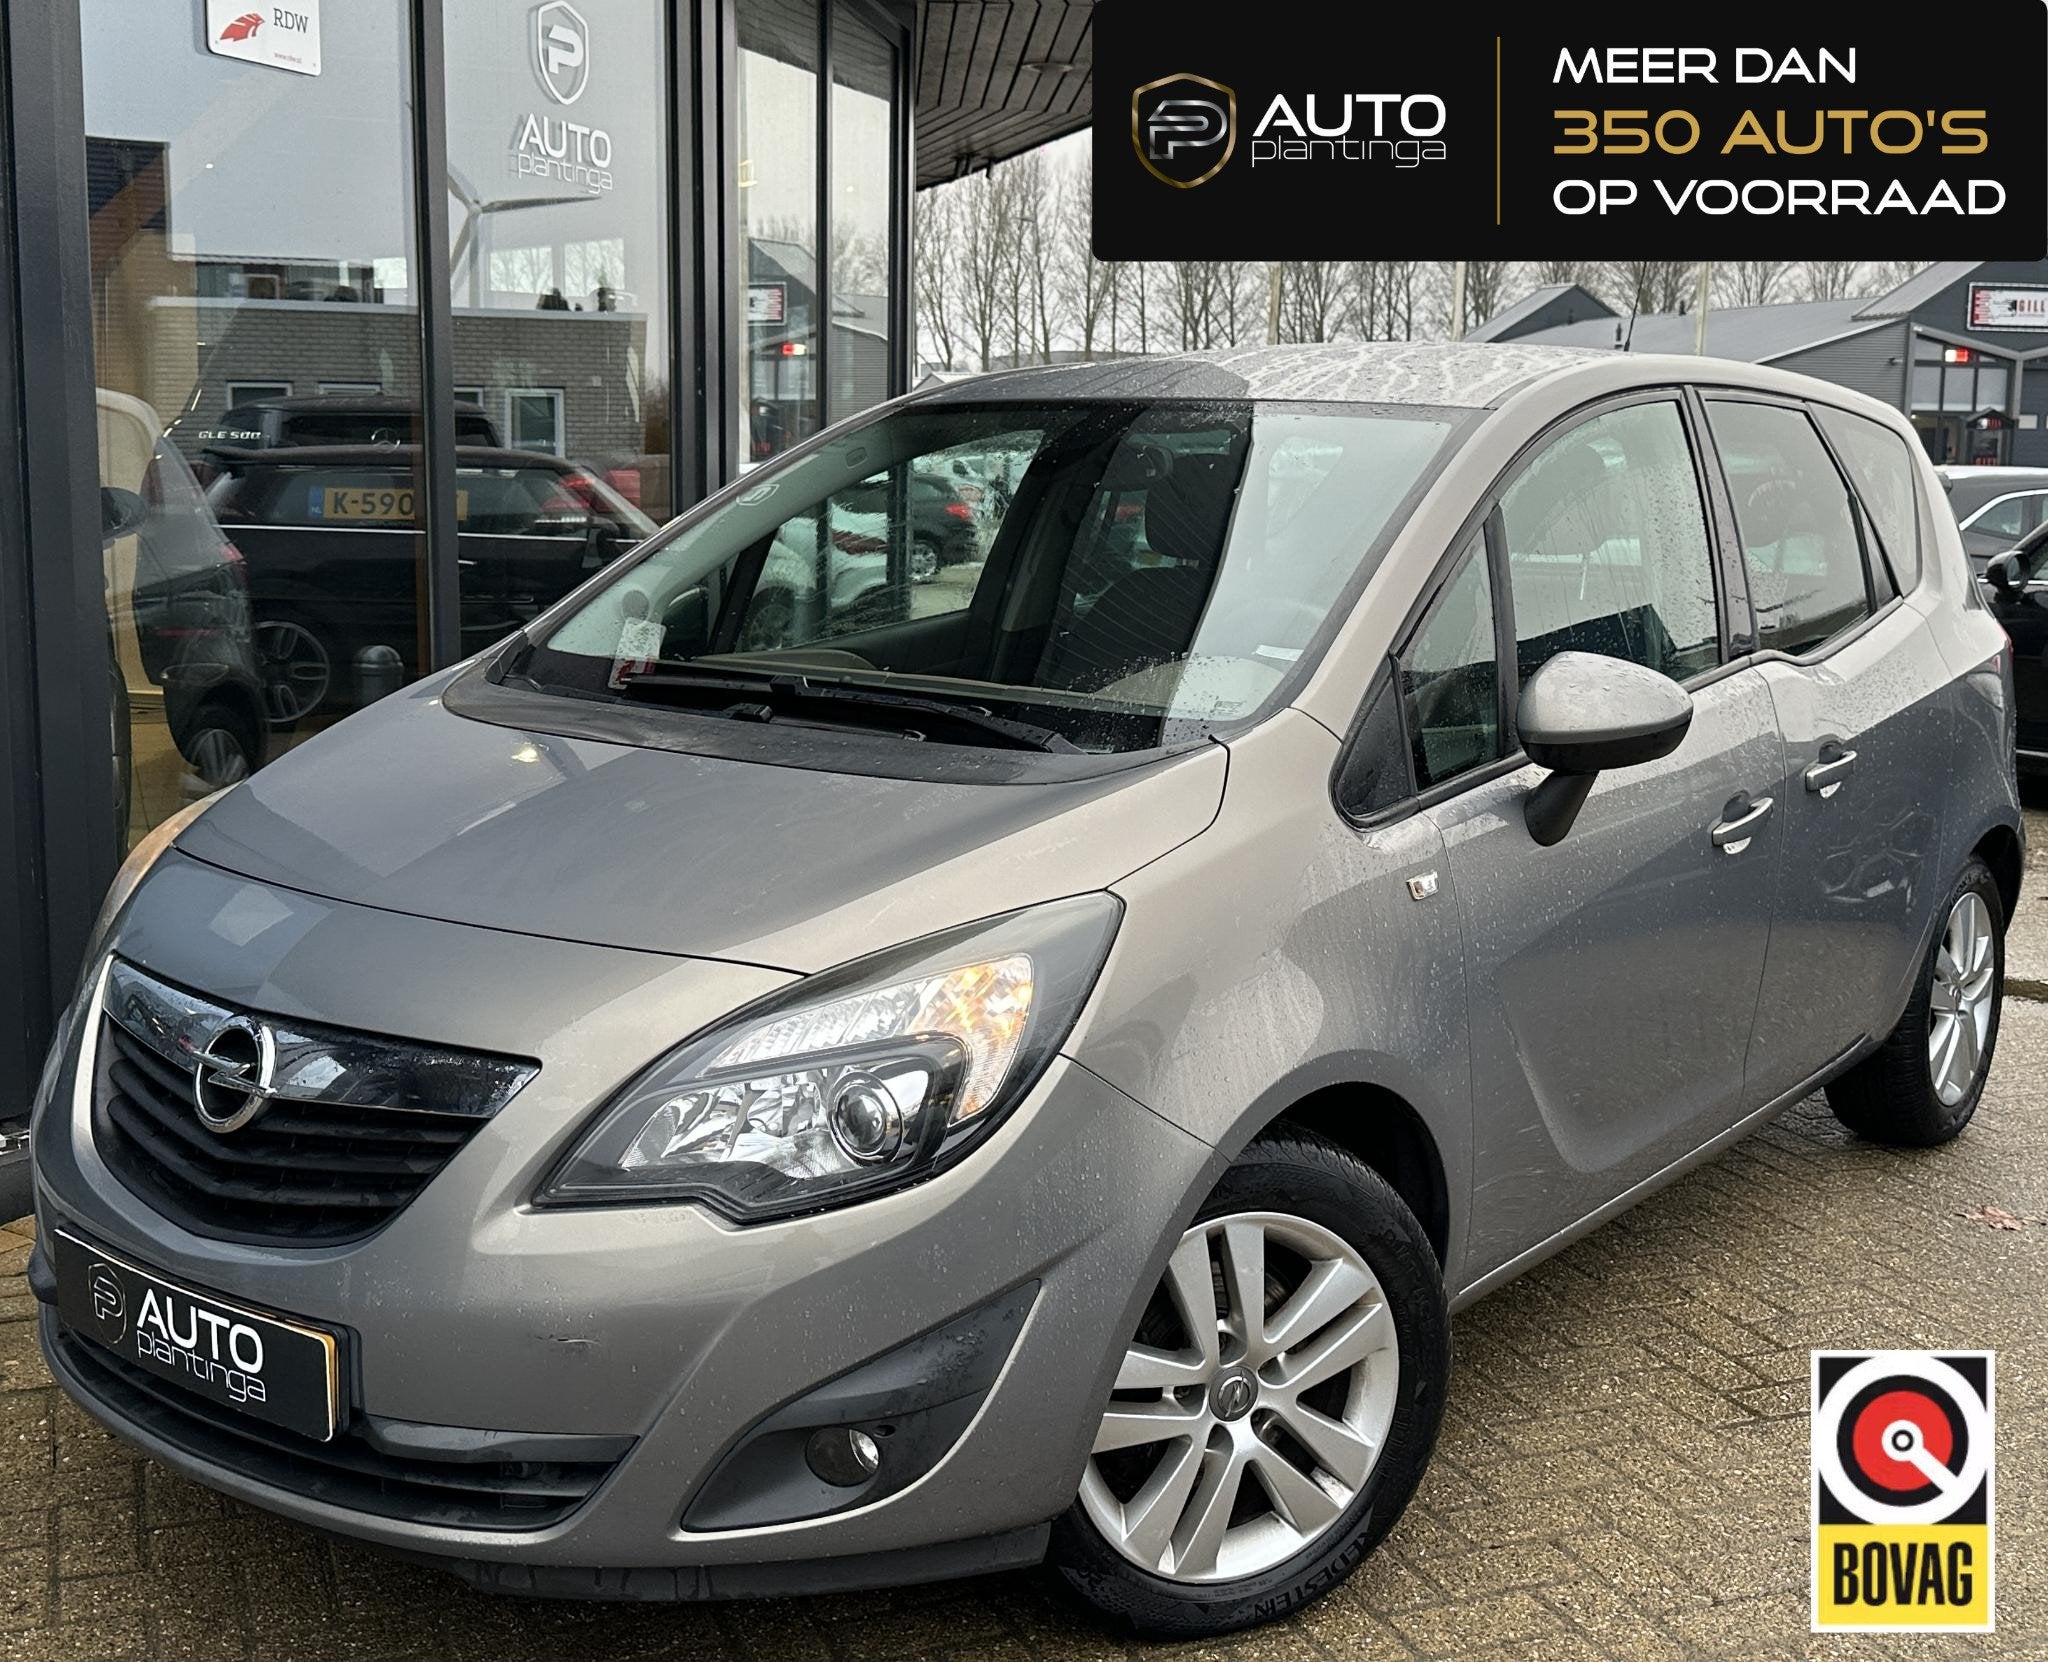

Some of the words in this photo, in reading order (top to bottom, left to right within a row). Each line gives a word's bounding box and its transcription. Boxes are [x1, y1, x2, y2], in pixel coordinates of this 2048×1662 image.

[273, 8, 309, 34] RDW
[518, 113, 613, 169] AUTO
[517, 151, 614, 195] plantinga
[2018, 299, 2046, 313] GILL
[198, 430, 228, 440] GLE
[332, 491, 415, 517] K-590
[136, 1288, 265, 1375] AUTO
[136, 1329, 267, 1403] plantinga
